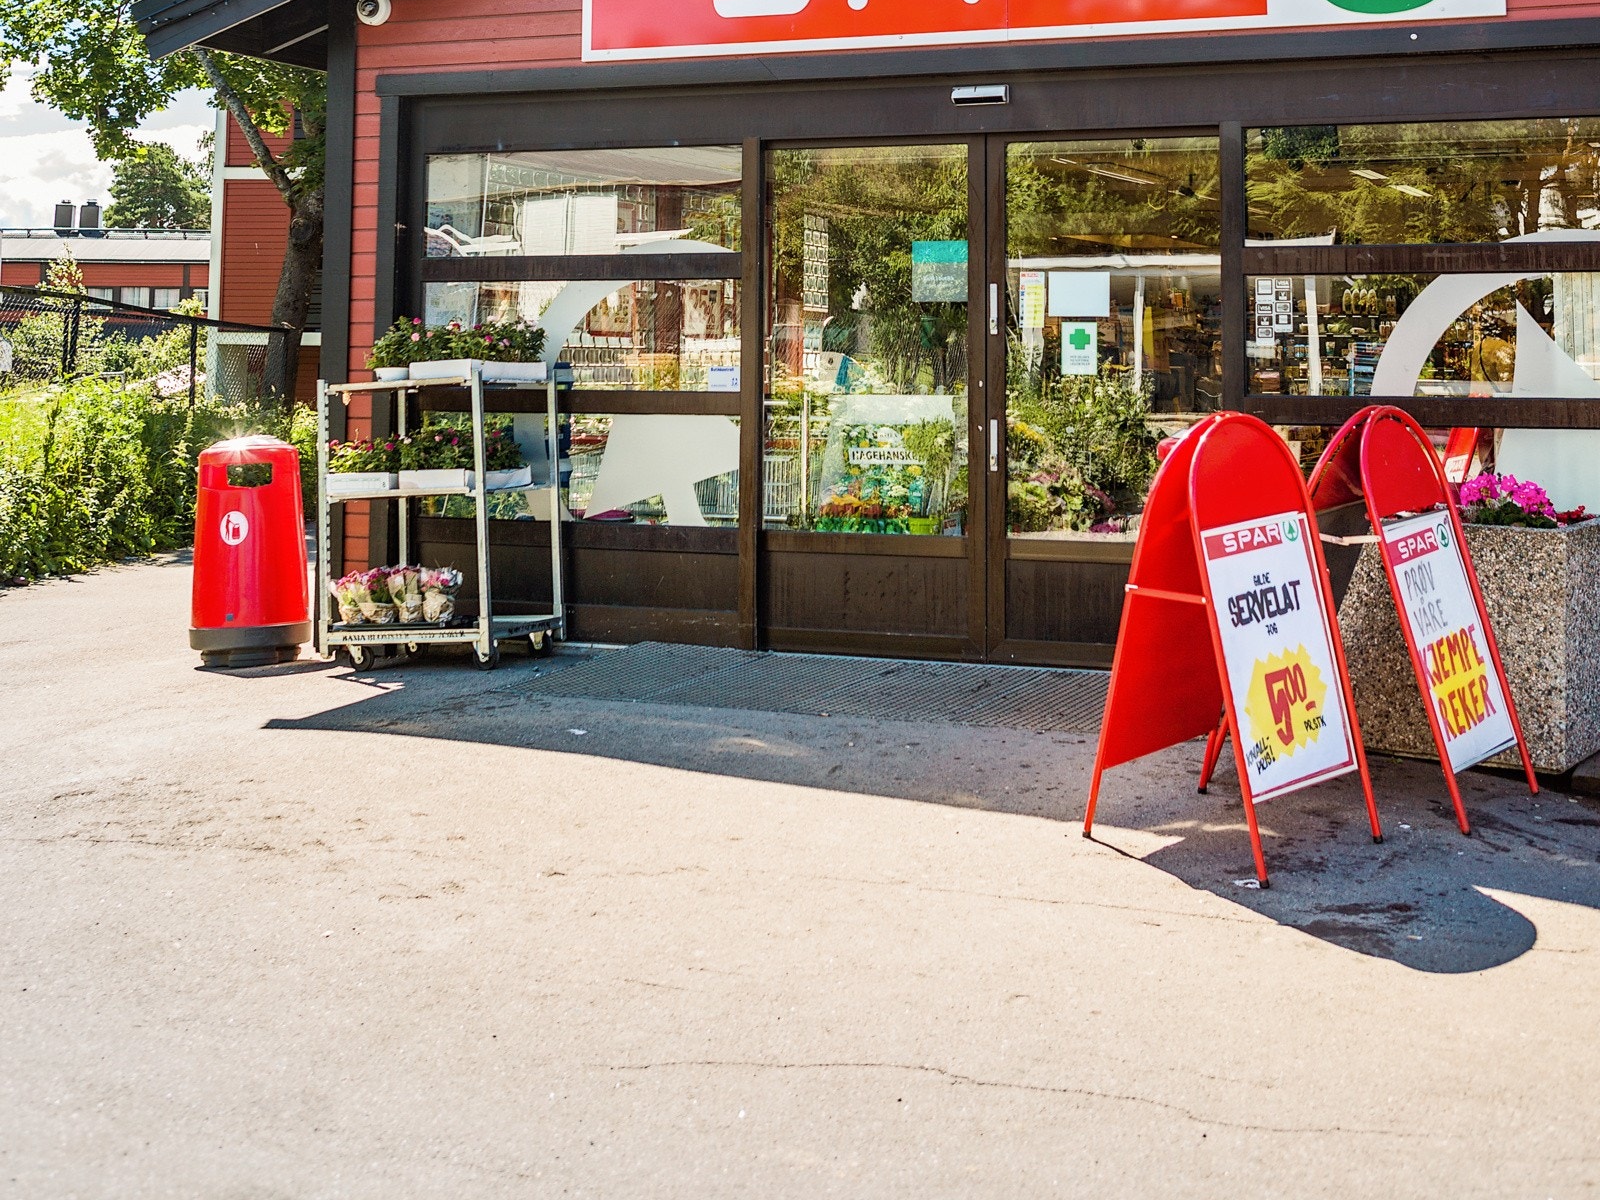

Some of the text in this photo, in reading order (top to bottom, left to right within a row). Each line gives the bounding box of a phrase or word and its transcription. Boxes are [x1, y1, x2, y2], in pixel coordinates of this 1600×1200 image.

[1222, 523, 1281, 553] SPAR
[1397, 531, 1437, 560] SPAR
[1404, 561, 1435, 601] PRØV
[1228, 579, 1300, 628] SERVELAT
[1413, 598, 1448, 637] VÅRE
[1418, 623, 1485, 690] KJEMPE
[1437, 674, 1497, 743] REKER
